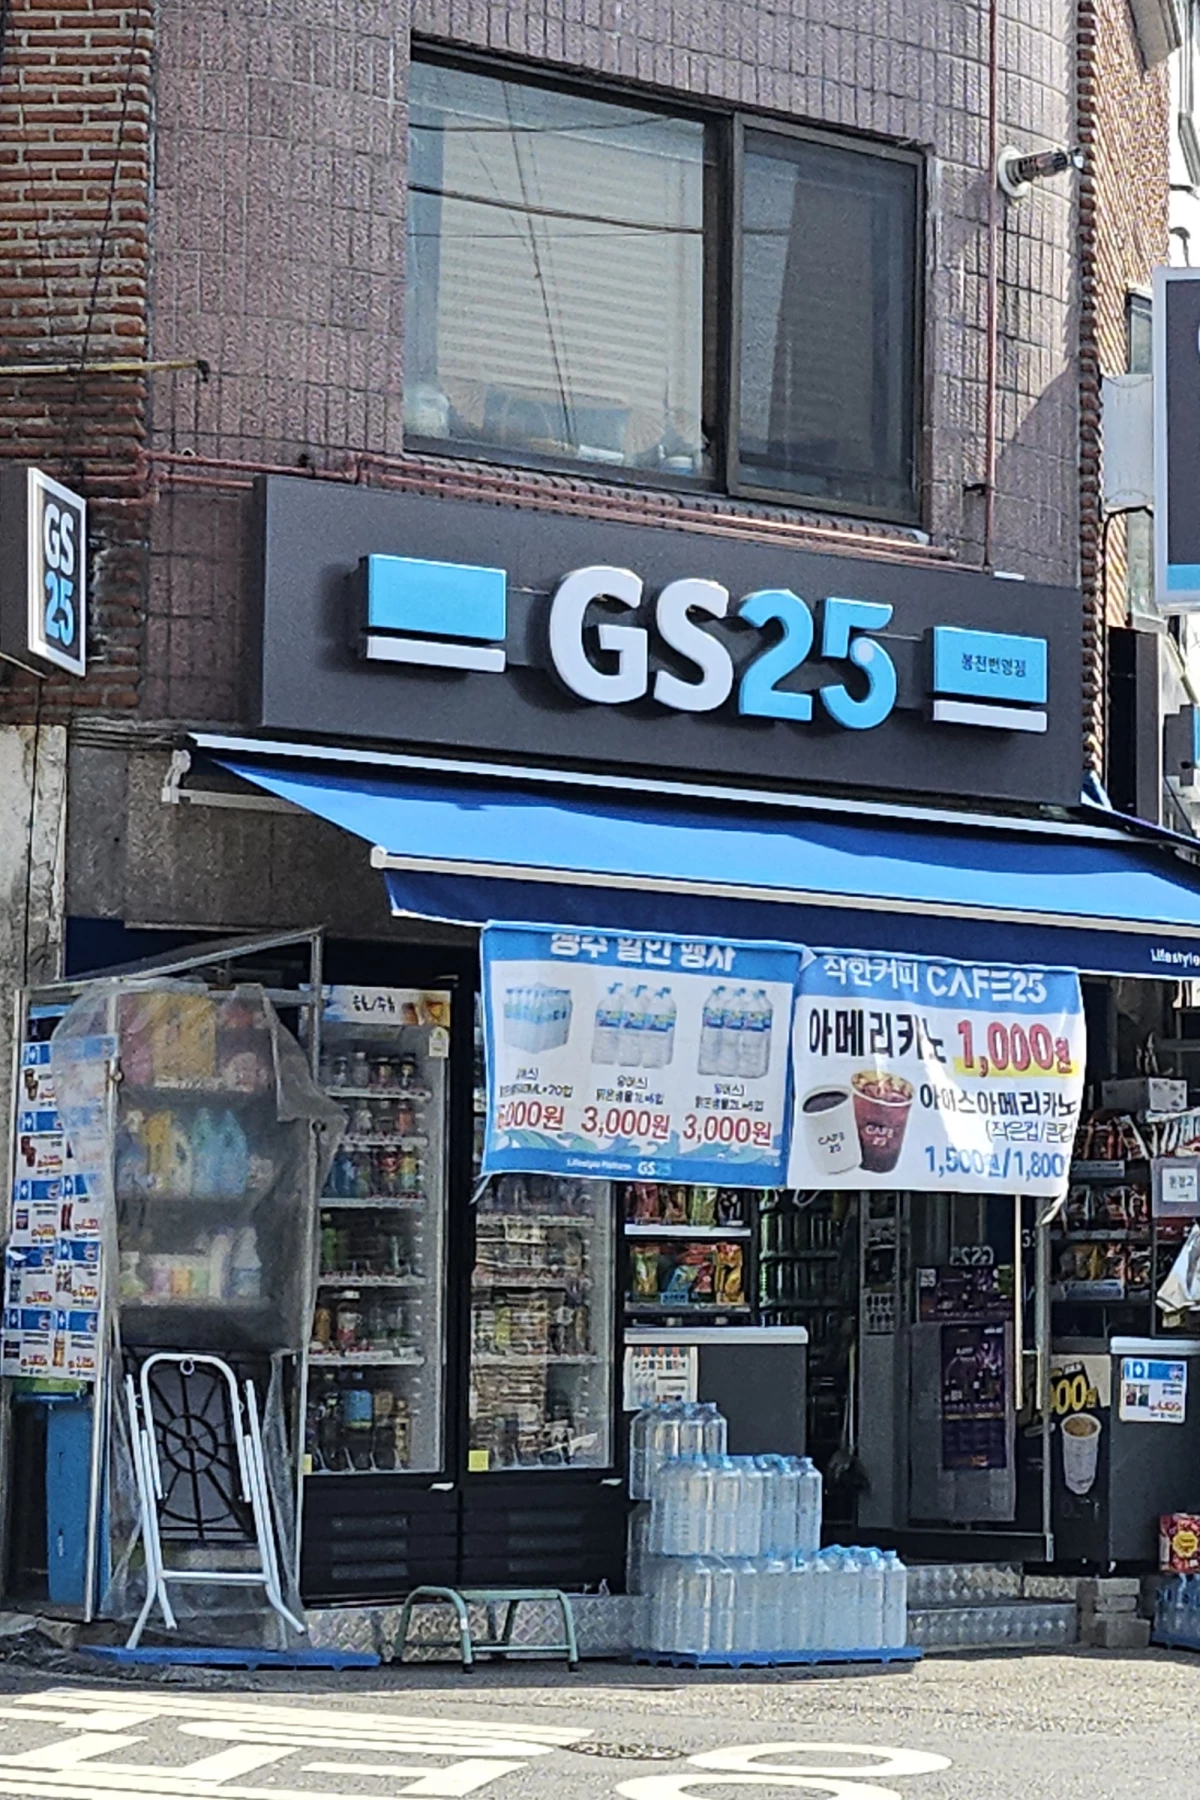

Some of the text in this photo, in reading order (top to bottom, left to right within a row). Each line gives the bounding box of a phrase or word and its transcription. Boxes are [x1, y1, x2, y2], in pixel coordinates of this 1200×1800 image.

[44, 503, 75, 576] GS
[44, 570, 75, 647] 25
[548, 565, 898, 731] GS25
[1150, 948, 1200, 969] Lifestyle
[808, 1008, 1074, 1077] 아메리카노 1,000원
[581, 1105, 670, 1140] 3,000원
[919, 1083, 1077, 1117] 아이스아메리카노
[682, 1113, 772, 1147] 3,000원
